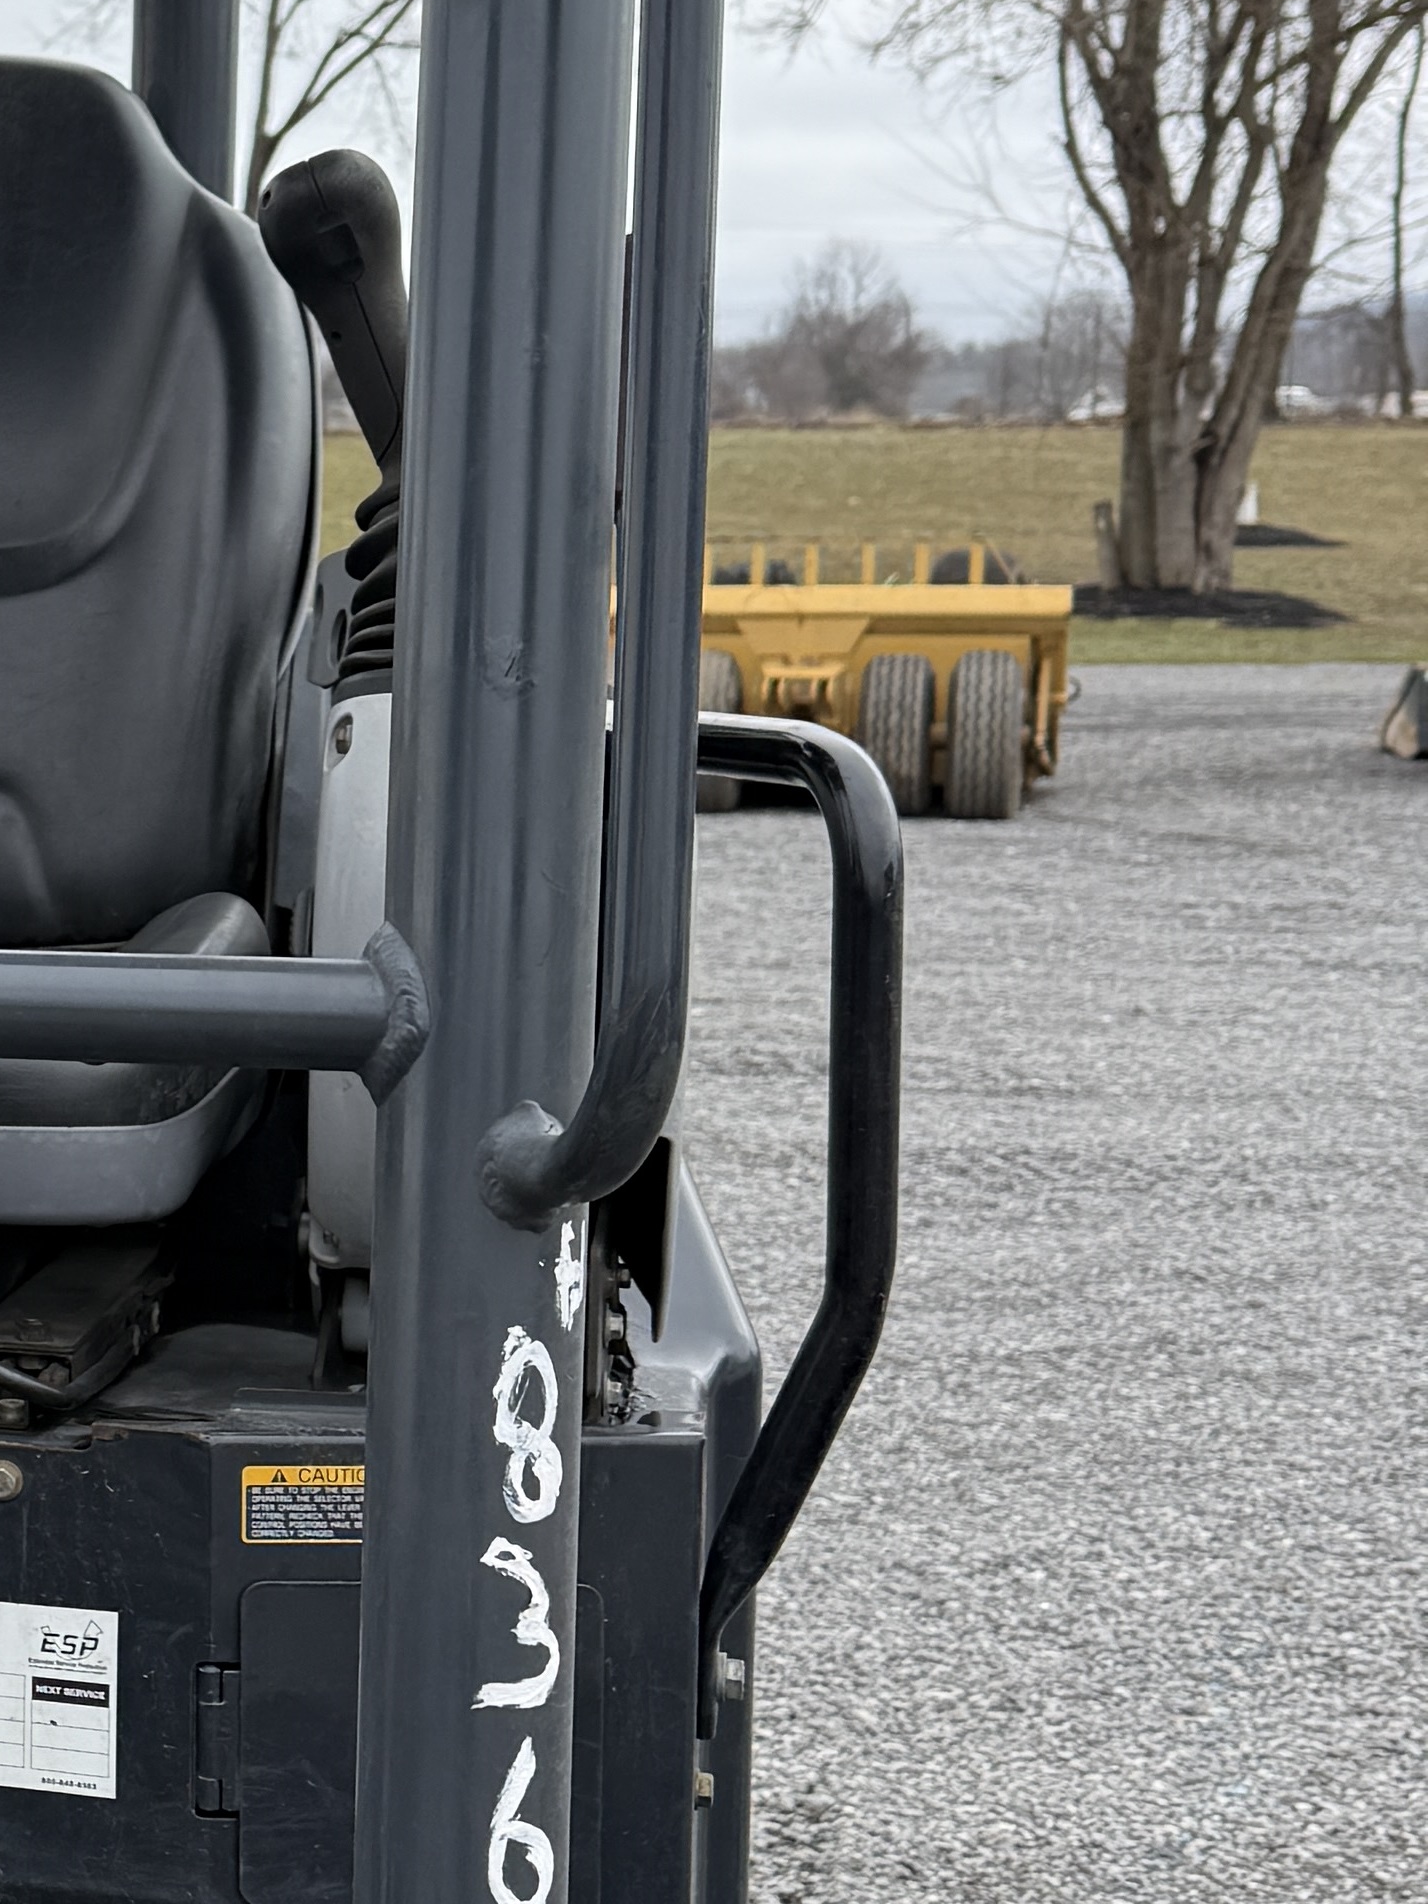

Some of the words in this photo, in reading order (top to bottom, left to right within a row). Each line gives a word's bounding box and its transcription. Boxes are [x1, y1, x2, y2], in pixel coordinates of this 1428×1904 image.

[40, 1632, 98, 1657] ESP
[36, 1684, 61, 1694] NEXT
[63, 1687, 104, 1699] SERVICE
